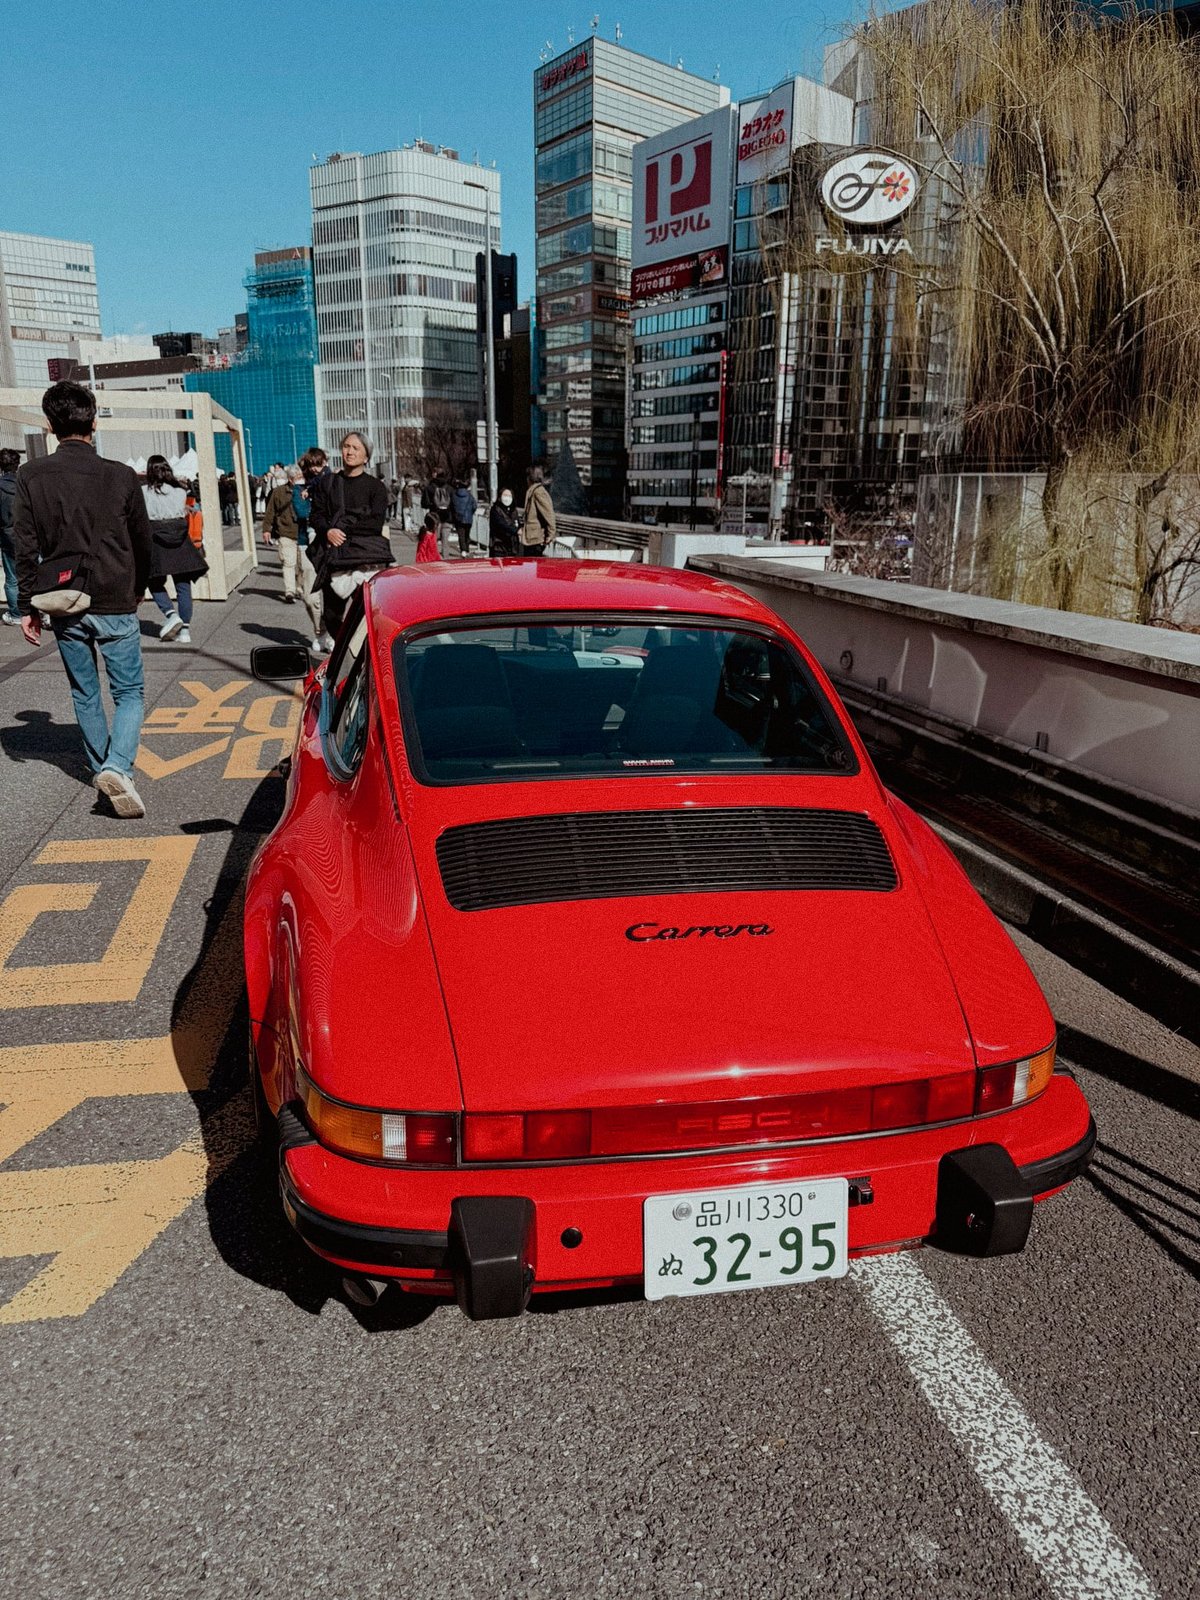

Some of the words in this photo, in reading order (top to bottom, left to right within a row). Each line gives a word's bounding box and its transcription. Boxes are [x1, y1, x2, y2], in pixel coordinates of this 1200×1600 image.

[645, 212, 711, 246] プリマハム
[815, 235, 913, 255] FUJIYA
[625, 922, 775, 942] Carrera
[692, 1221, 836, 1286] 32-95
